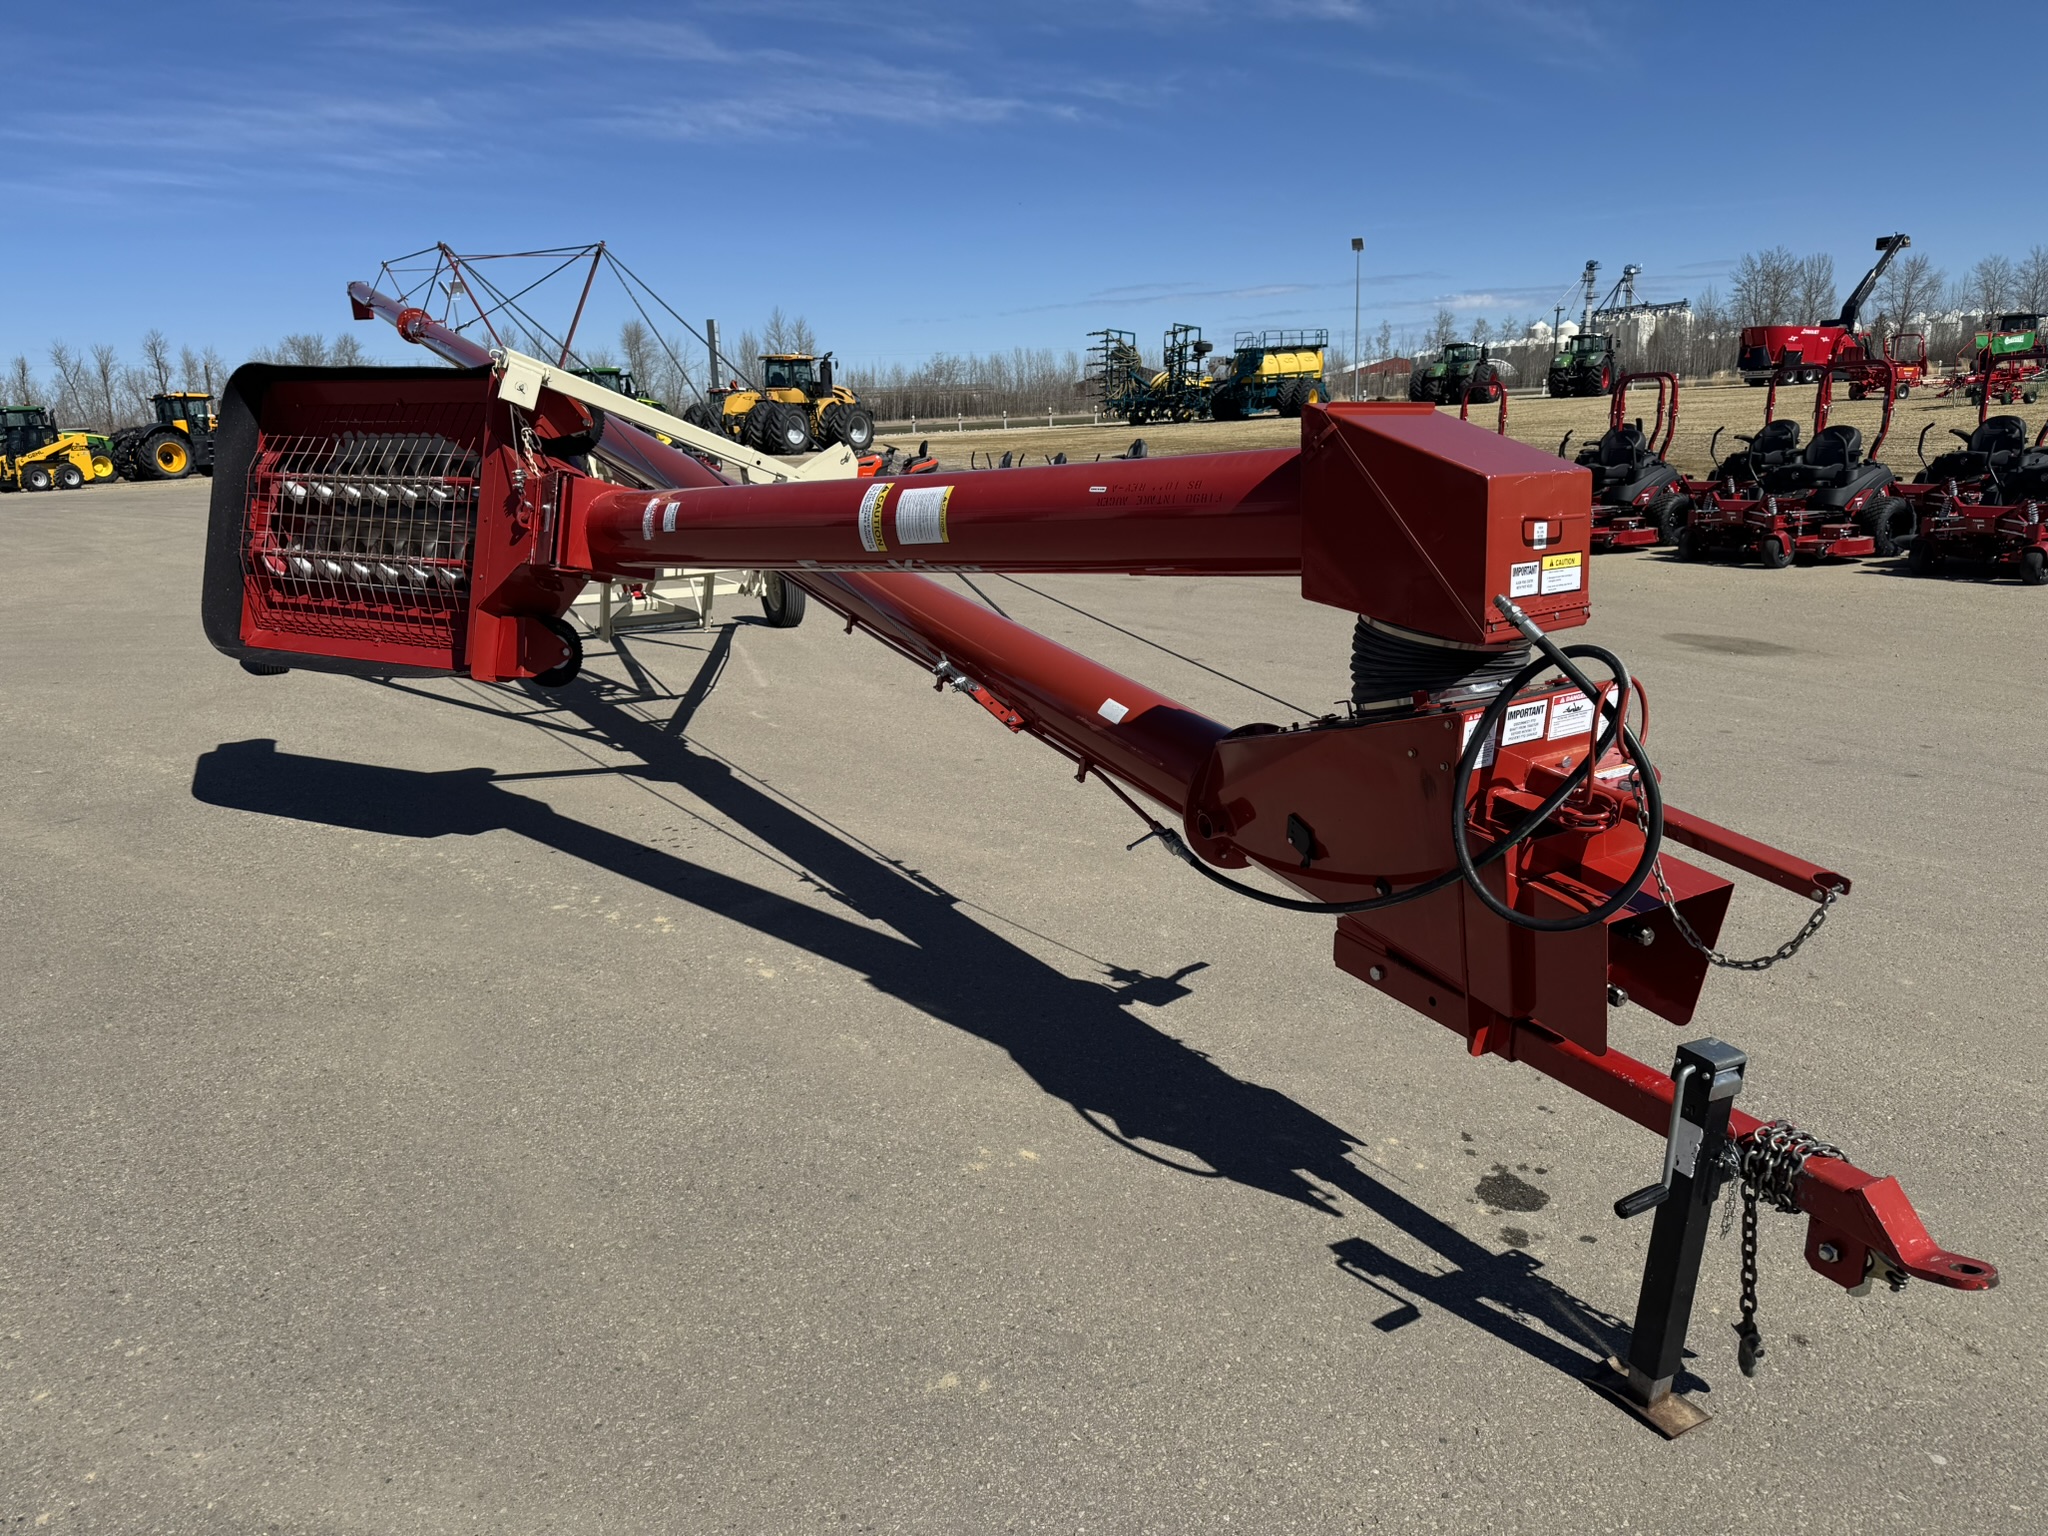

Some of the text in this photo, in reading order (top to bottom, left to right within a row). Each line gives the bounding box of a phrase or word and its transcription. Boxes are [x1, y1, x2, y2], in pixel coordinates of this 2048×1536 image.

[28, 450, 44, 459] GEHL
[1136, 494, 1176, 506] INTAKE
[873, 495, 884, 547] CAUTION
[1555, 558, 1576, 566] CAUTION
[1512, 565, 1538, 578] IMPORTANT
[1508, 704, 1545, 720] IMPORTANT
